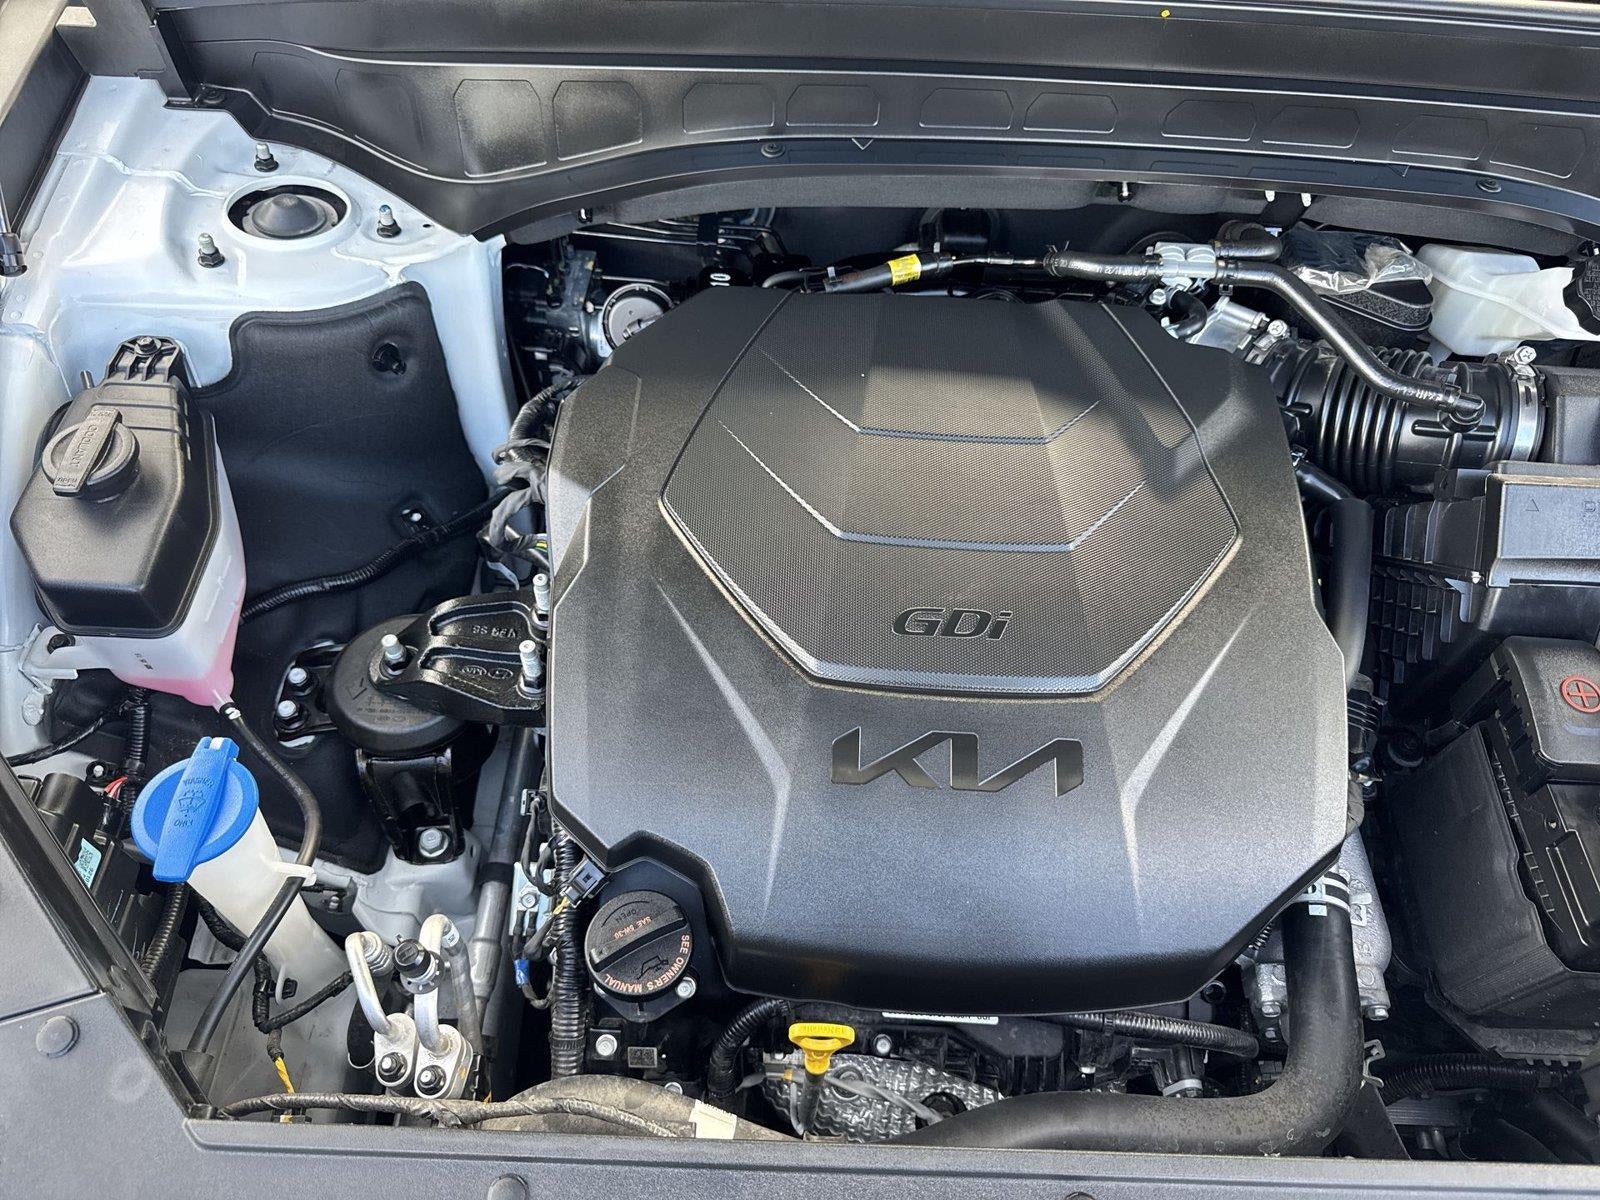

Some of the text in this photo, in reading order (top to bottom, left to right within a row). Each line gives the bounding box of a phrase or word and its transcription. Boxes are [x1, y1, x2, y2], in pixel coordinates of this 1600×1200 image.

[70, 424, 98, 468] COOLANT
[892, 606, 1014, 641] GDi
[831, 726, 1084, 797] KIA
[637, 916, 652, 928] SAE
[604, 934, 690, 994] SEE OWNER'S MANUAL
